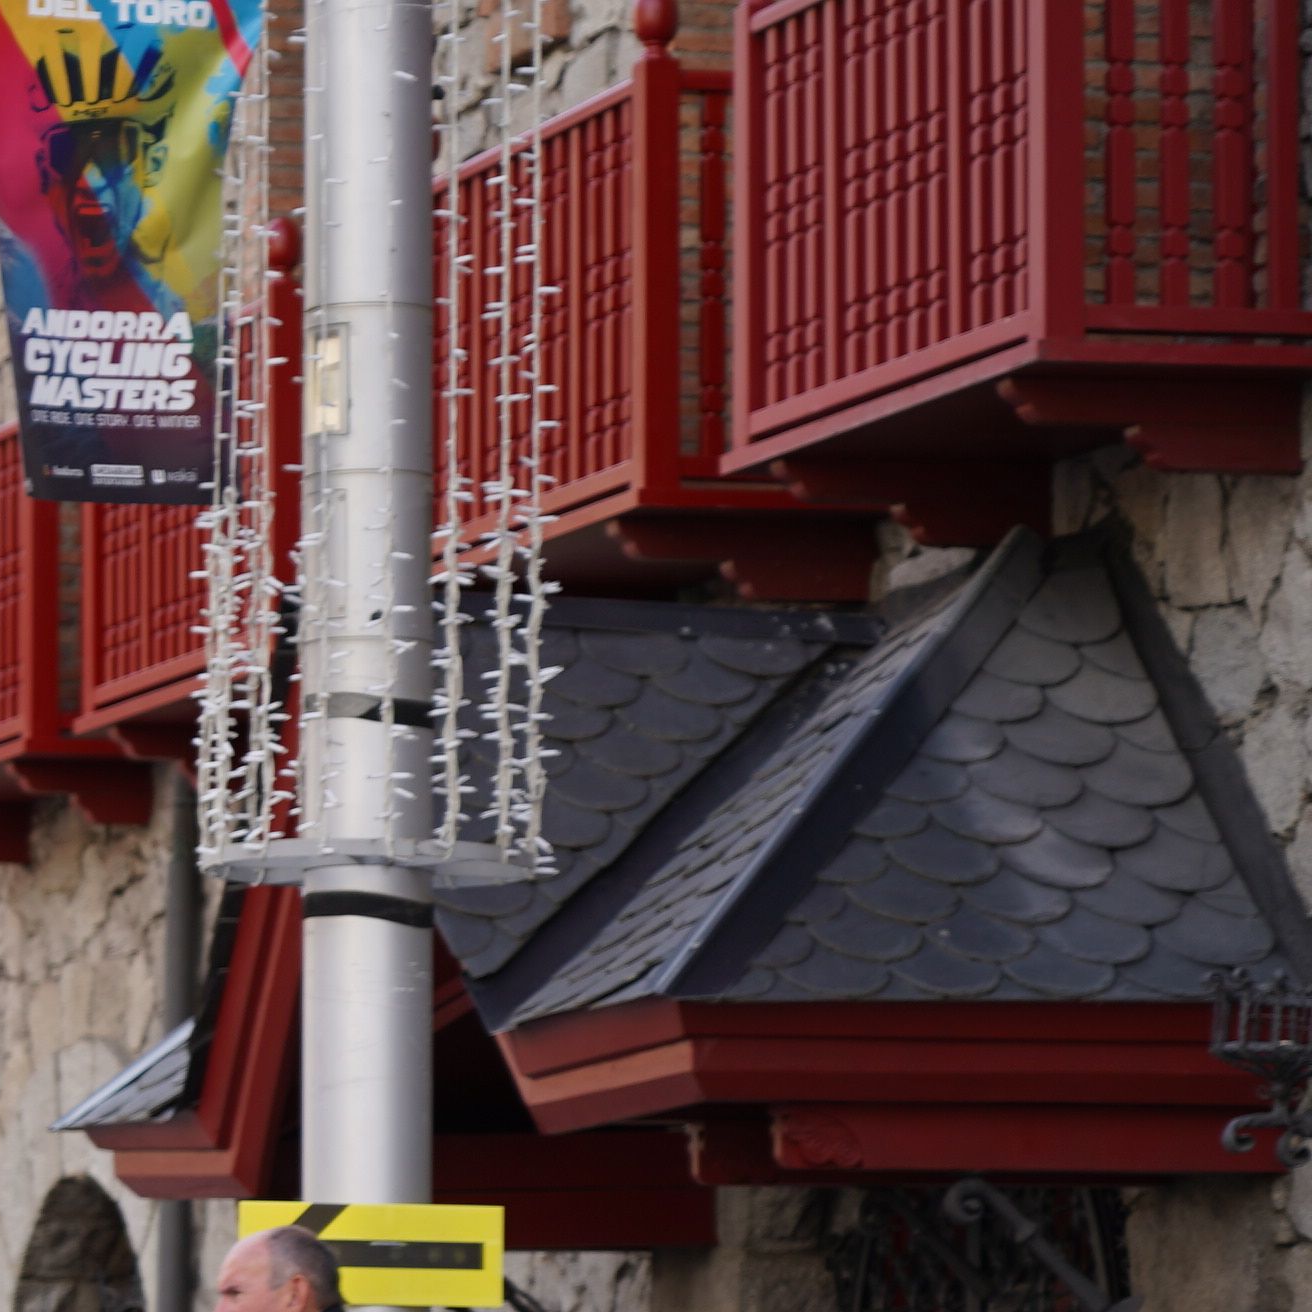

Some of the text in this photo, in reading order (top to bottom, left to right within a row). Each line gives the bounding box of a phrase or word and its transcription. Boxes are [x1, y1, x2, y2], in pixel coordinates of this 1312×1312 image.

[28, 0, 213, 28] DEL TORO
[21, 307, 194, 341] ANDORRA
[24, 337, 194, 378] CYCLING
[29, 375, 197, 411] MASTERS
